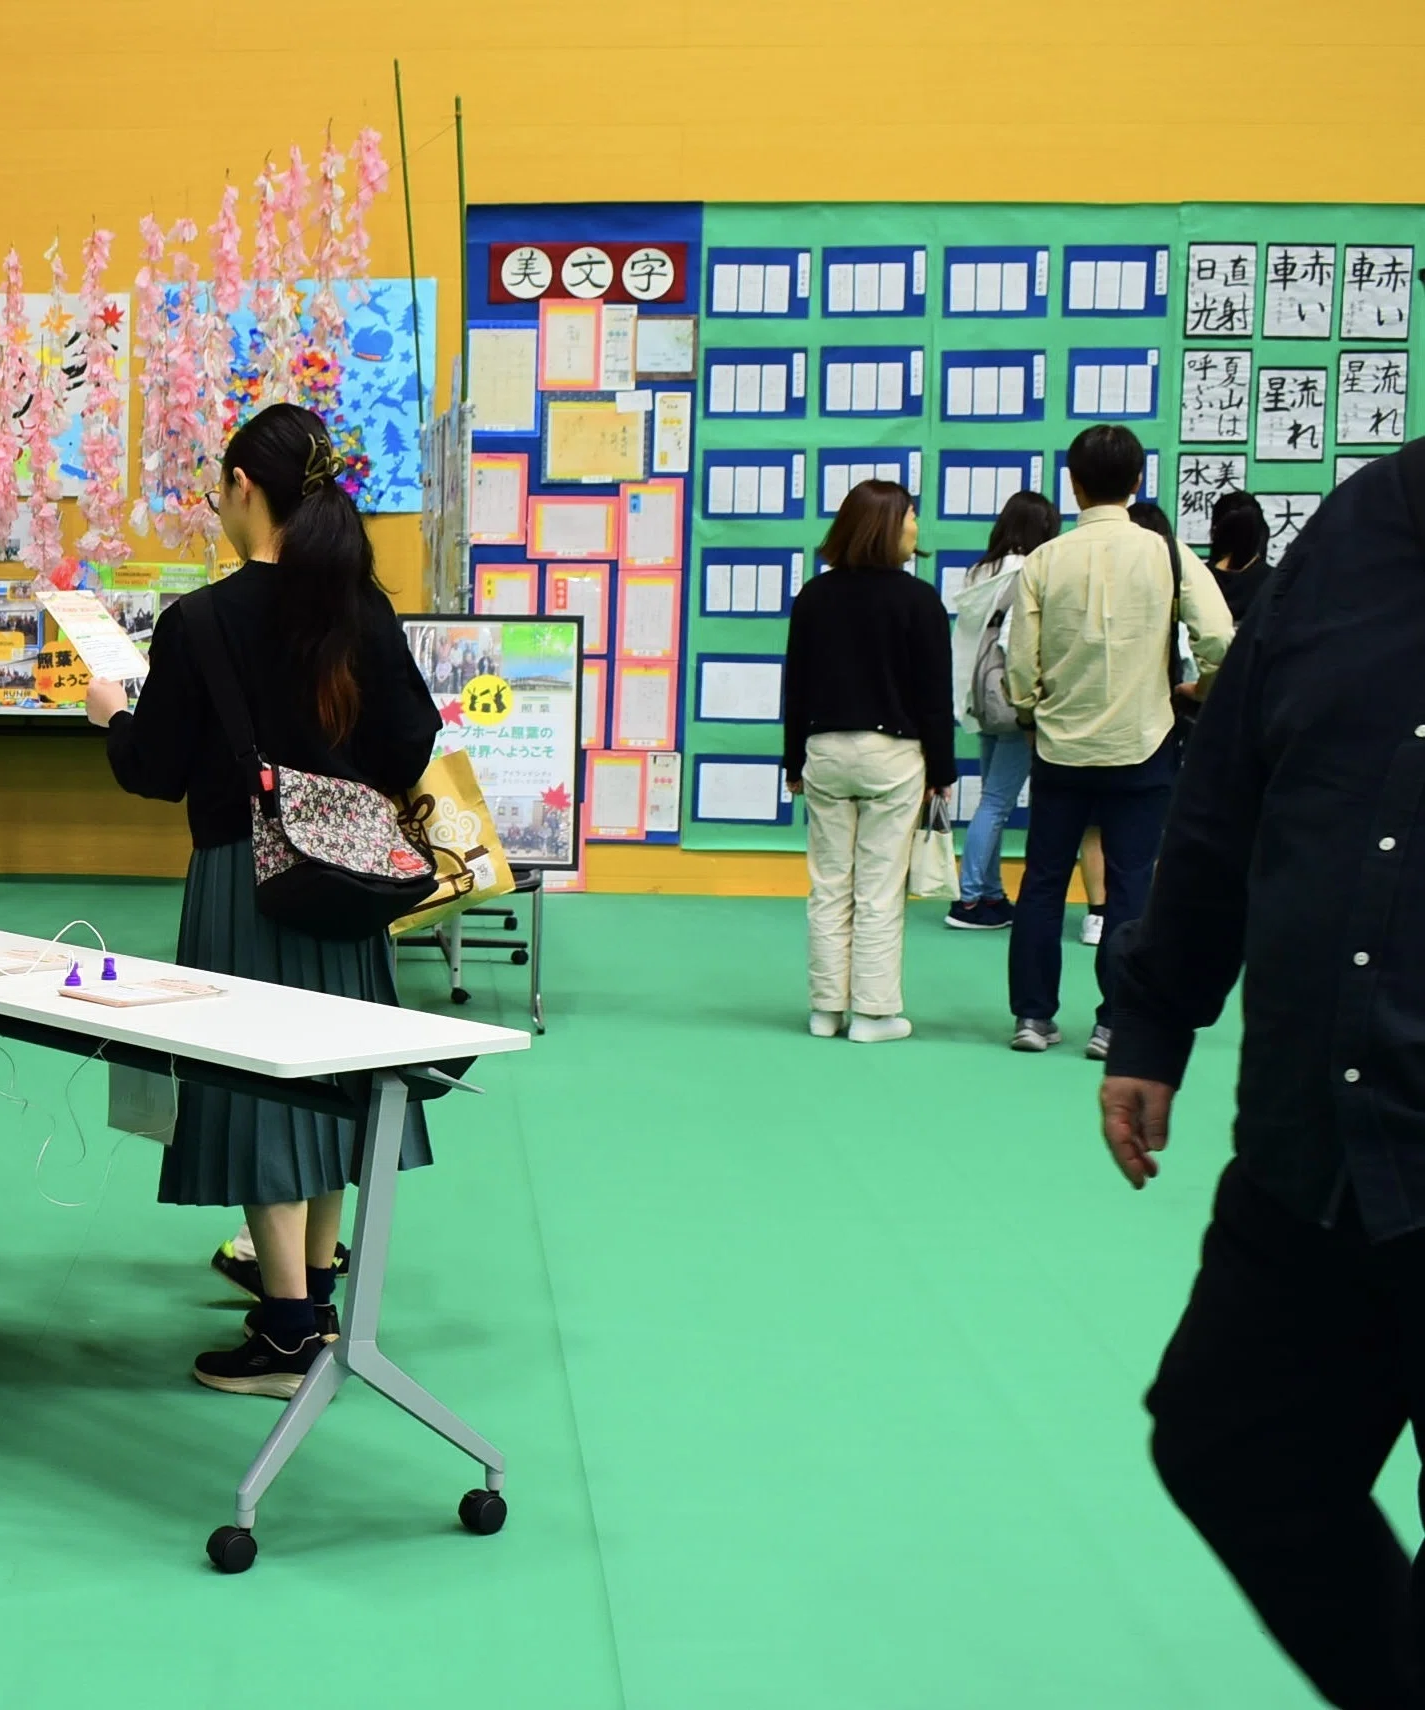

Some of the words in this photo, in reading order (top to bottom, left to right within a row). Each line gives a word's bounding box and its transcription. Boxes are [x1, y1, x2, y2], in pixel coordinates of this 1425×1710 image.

[508, 250, 668, 291] 美文字
[1190, 258, 1220, 331] 日光
[1216, 254, 1250, 331] 直射
[1269, 249, 1298, 292] 車
[1298, 249, 1335, 322] 赤い
[1347, 251, 1375, 292] 車
[1376, 255, 1409, 327] 赤い
[1182, 354, 1218, 419] 呼ぶ
[1216, 356, 1246, 437] 夏山は
[1262, 376, 1291, 413] 星
[1343, 360, 1365, 393] 星
[1369, 360, 1406, 437] 流れ
[1287, 376, 1323, 450] 流れ
[54, 673, 89, 688] ようこ
